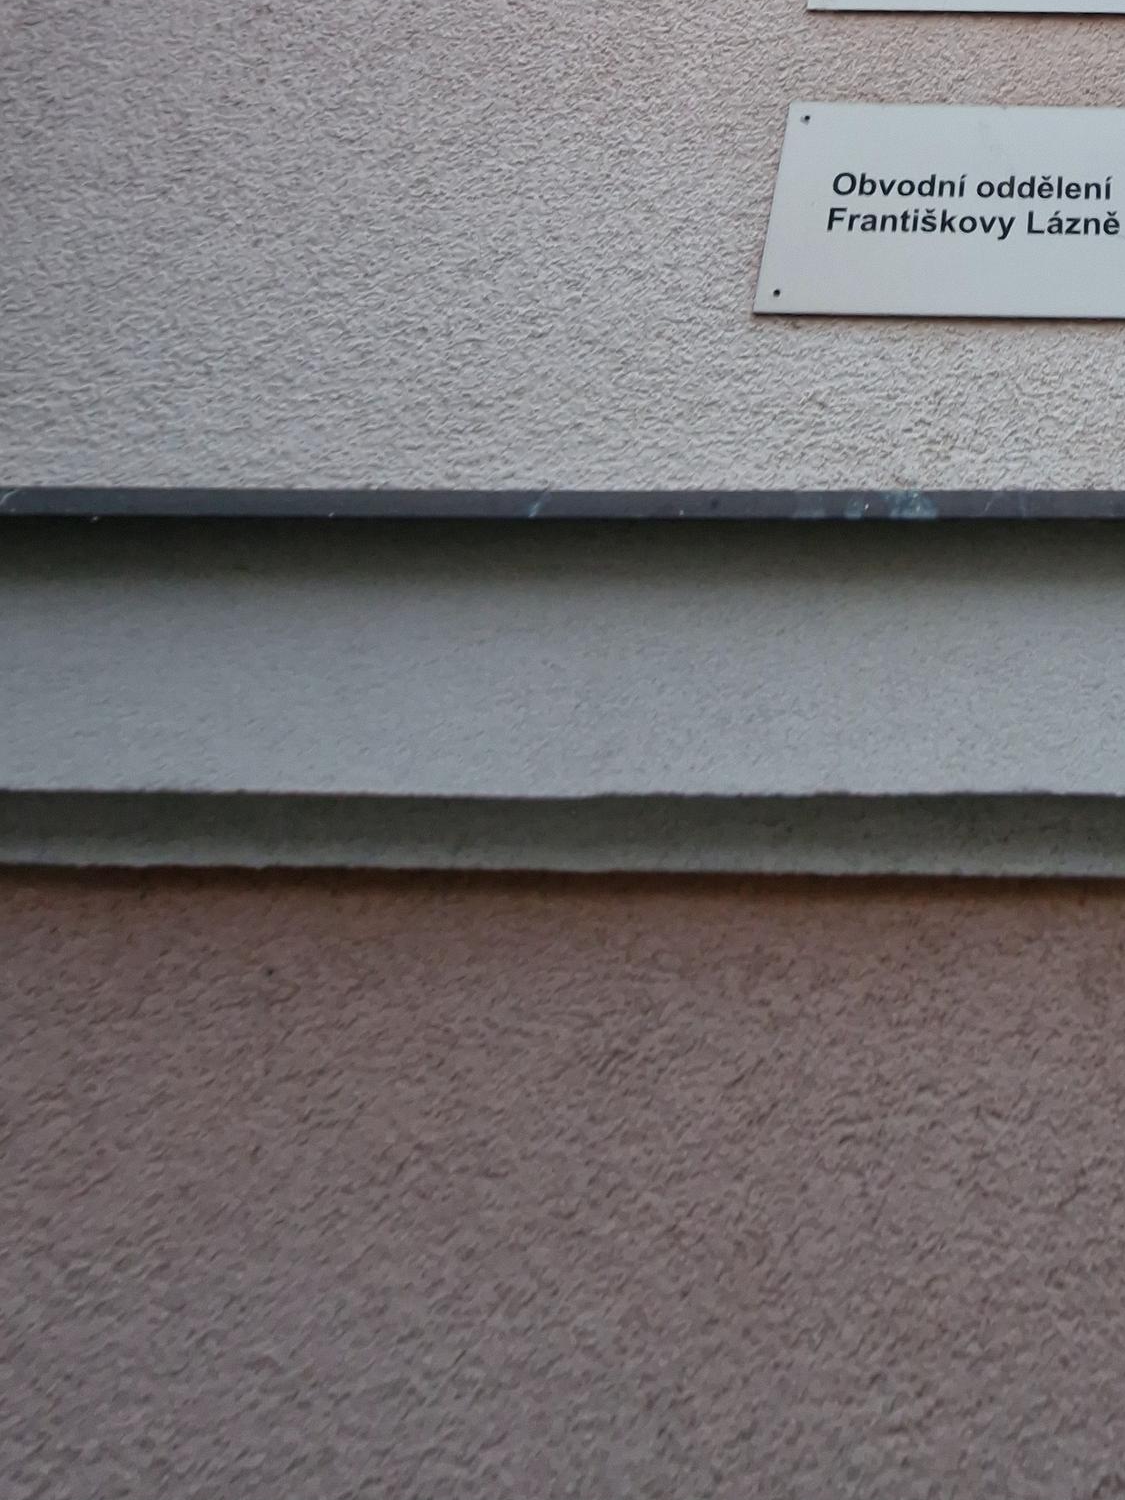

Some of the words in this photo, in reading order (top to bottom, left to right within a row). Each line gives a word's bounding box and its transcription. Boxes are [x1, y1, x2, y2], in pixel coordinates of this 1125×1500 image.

[832, 172, 967, 198] Obvodní
[976, 175, 1113, 200] oddělení
[826, 206, 1016, 240] Františkovy
[1027, 210, 1121, 236] Lázně
